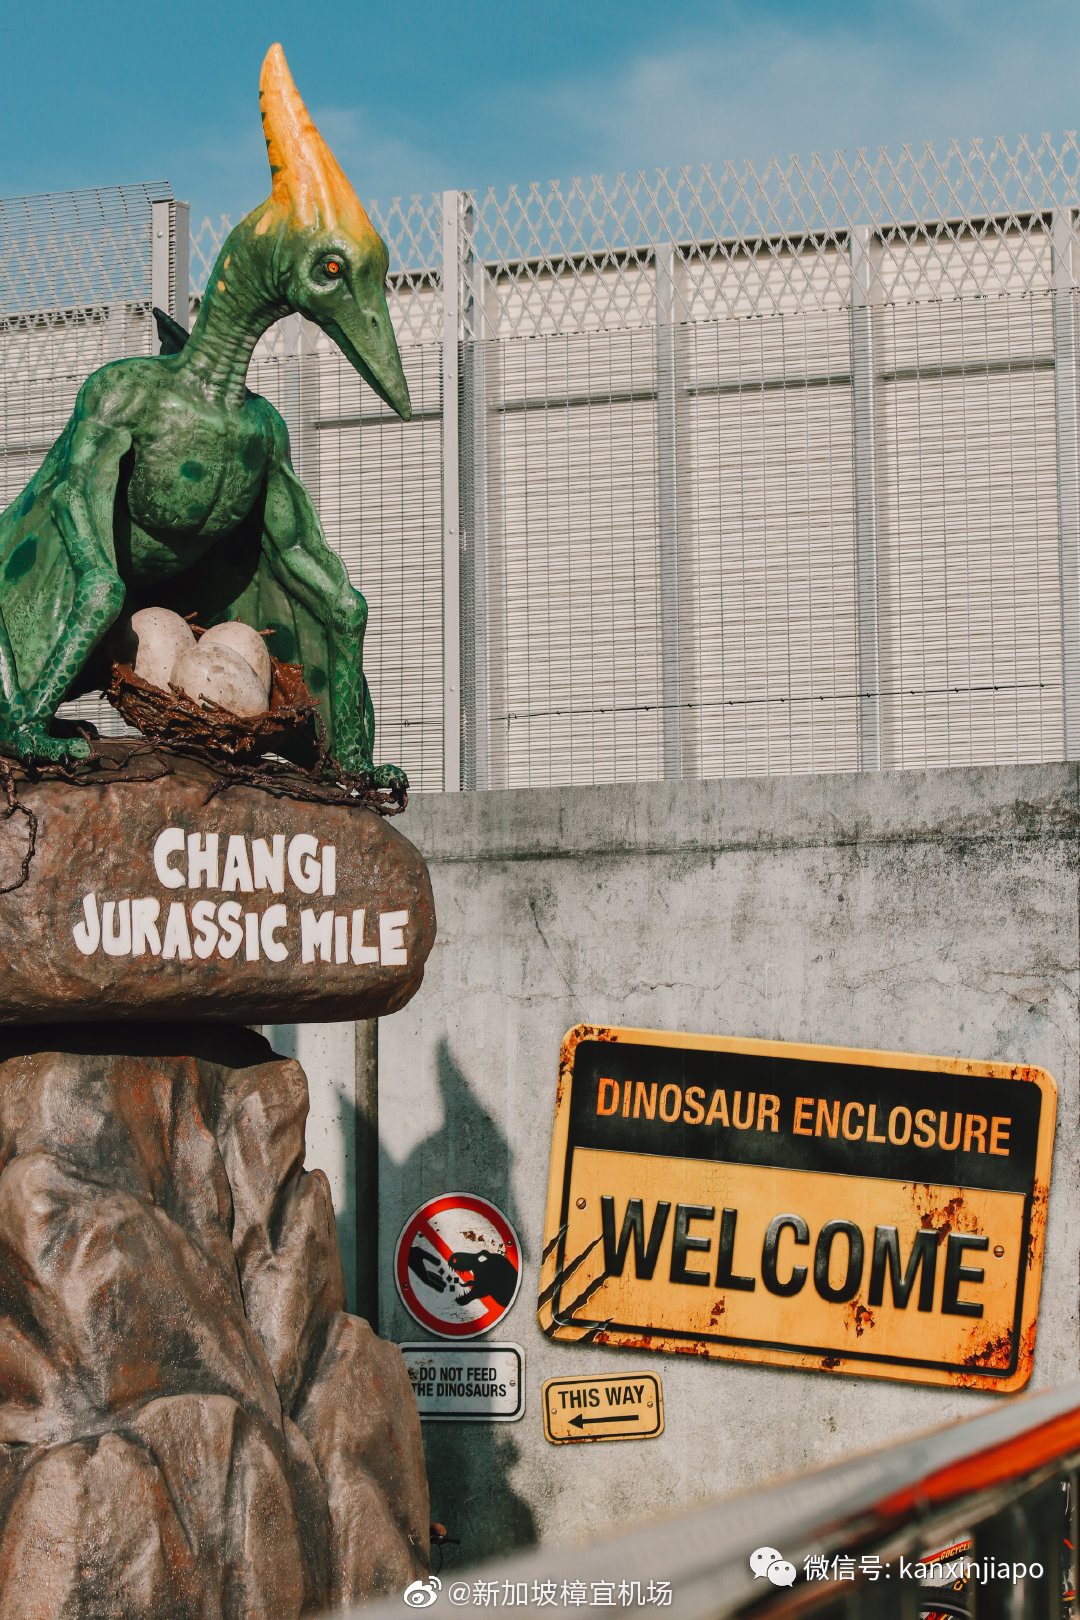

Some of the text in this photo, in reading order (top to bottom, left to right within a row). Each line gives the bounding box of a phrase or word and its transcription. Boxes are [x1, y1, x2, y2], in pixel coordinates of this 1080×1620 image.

[154, 827, 336, 896] CHANGI
[72, 893, 408, 966] JURASSIC MILE
[596, 1077, 1012, 1156] DINOSAUR ENCLOSURE
[600, 1194, 990, 1319] WELCOME
[420, 1367, 497, 1381] DO NOT FEED
[437, 1383, 507, 1397] DINOSAURS
[558, 1385, 645, 1410] THIS WAY
